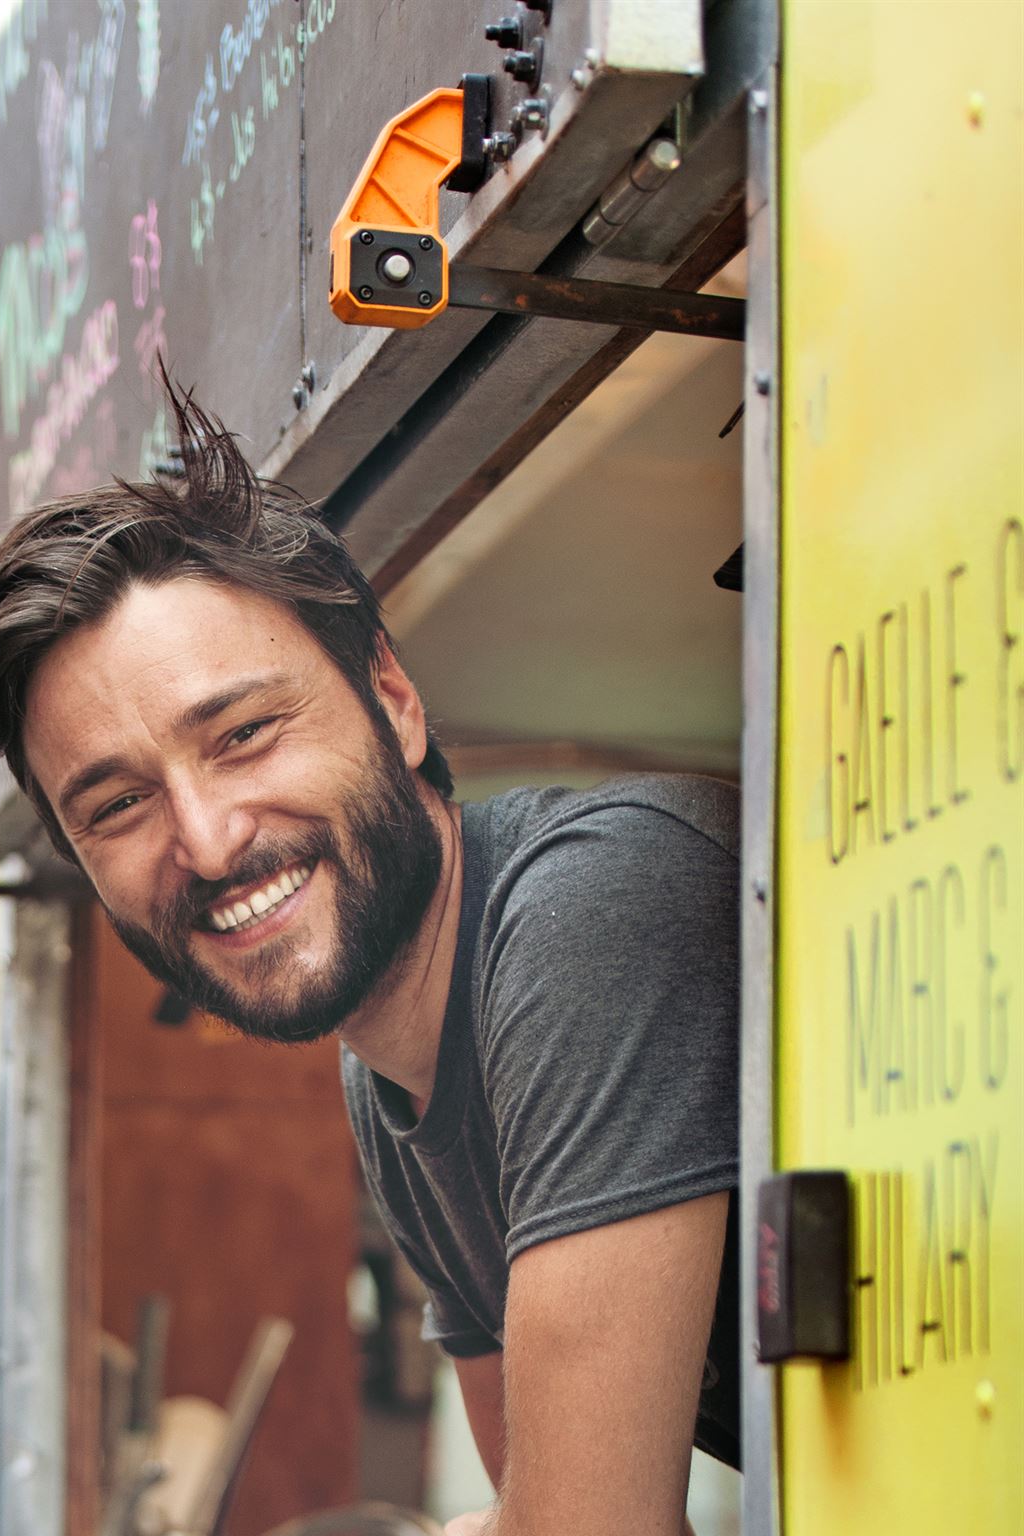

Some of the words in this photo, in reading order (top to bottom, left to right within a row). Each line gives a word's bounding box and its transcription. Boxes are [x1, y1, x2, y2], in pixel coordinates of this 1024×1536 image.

[825, 563, 971, 866] GAELLE
[845, 864, 966, 1129] MARC
[853, 1130, 1000, 1392] HILARY
